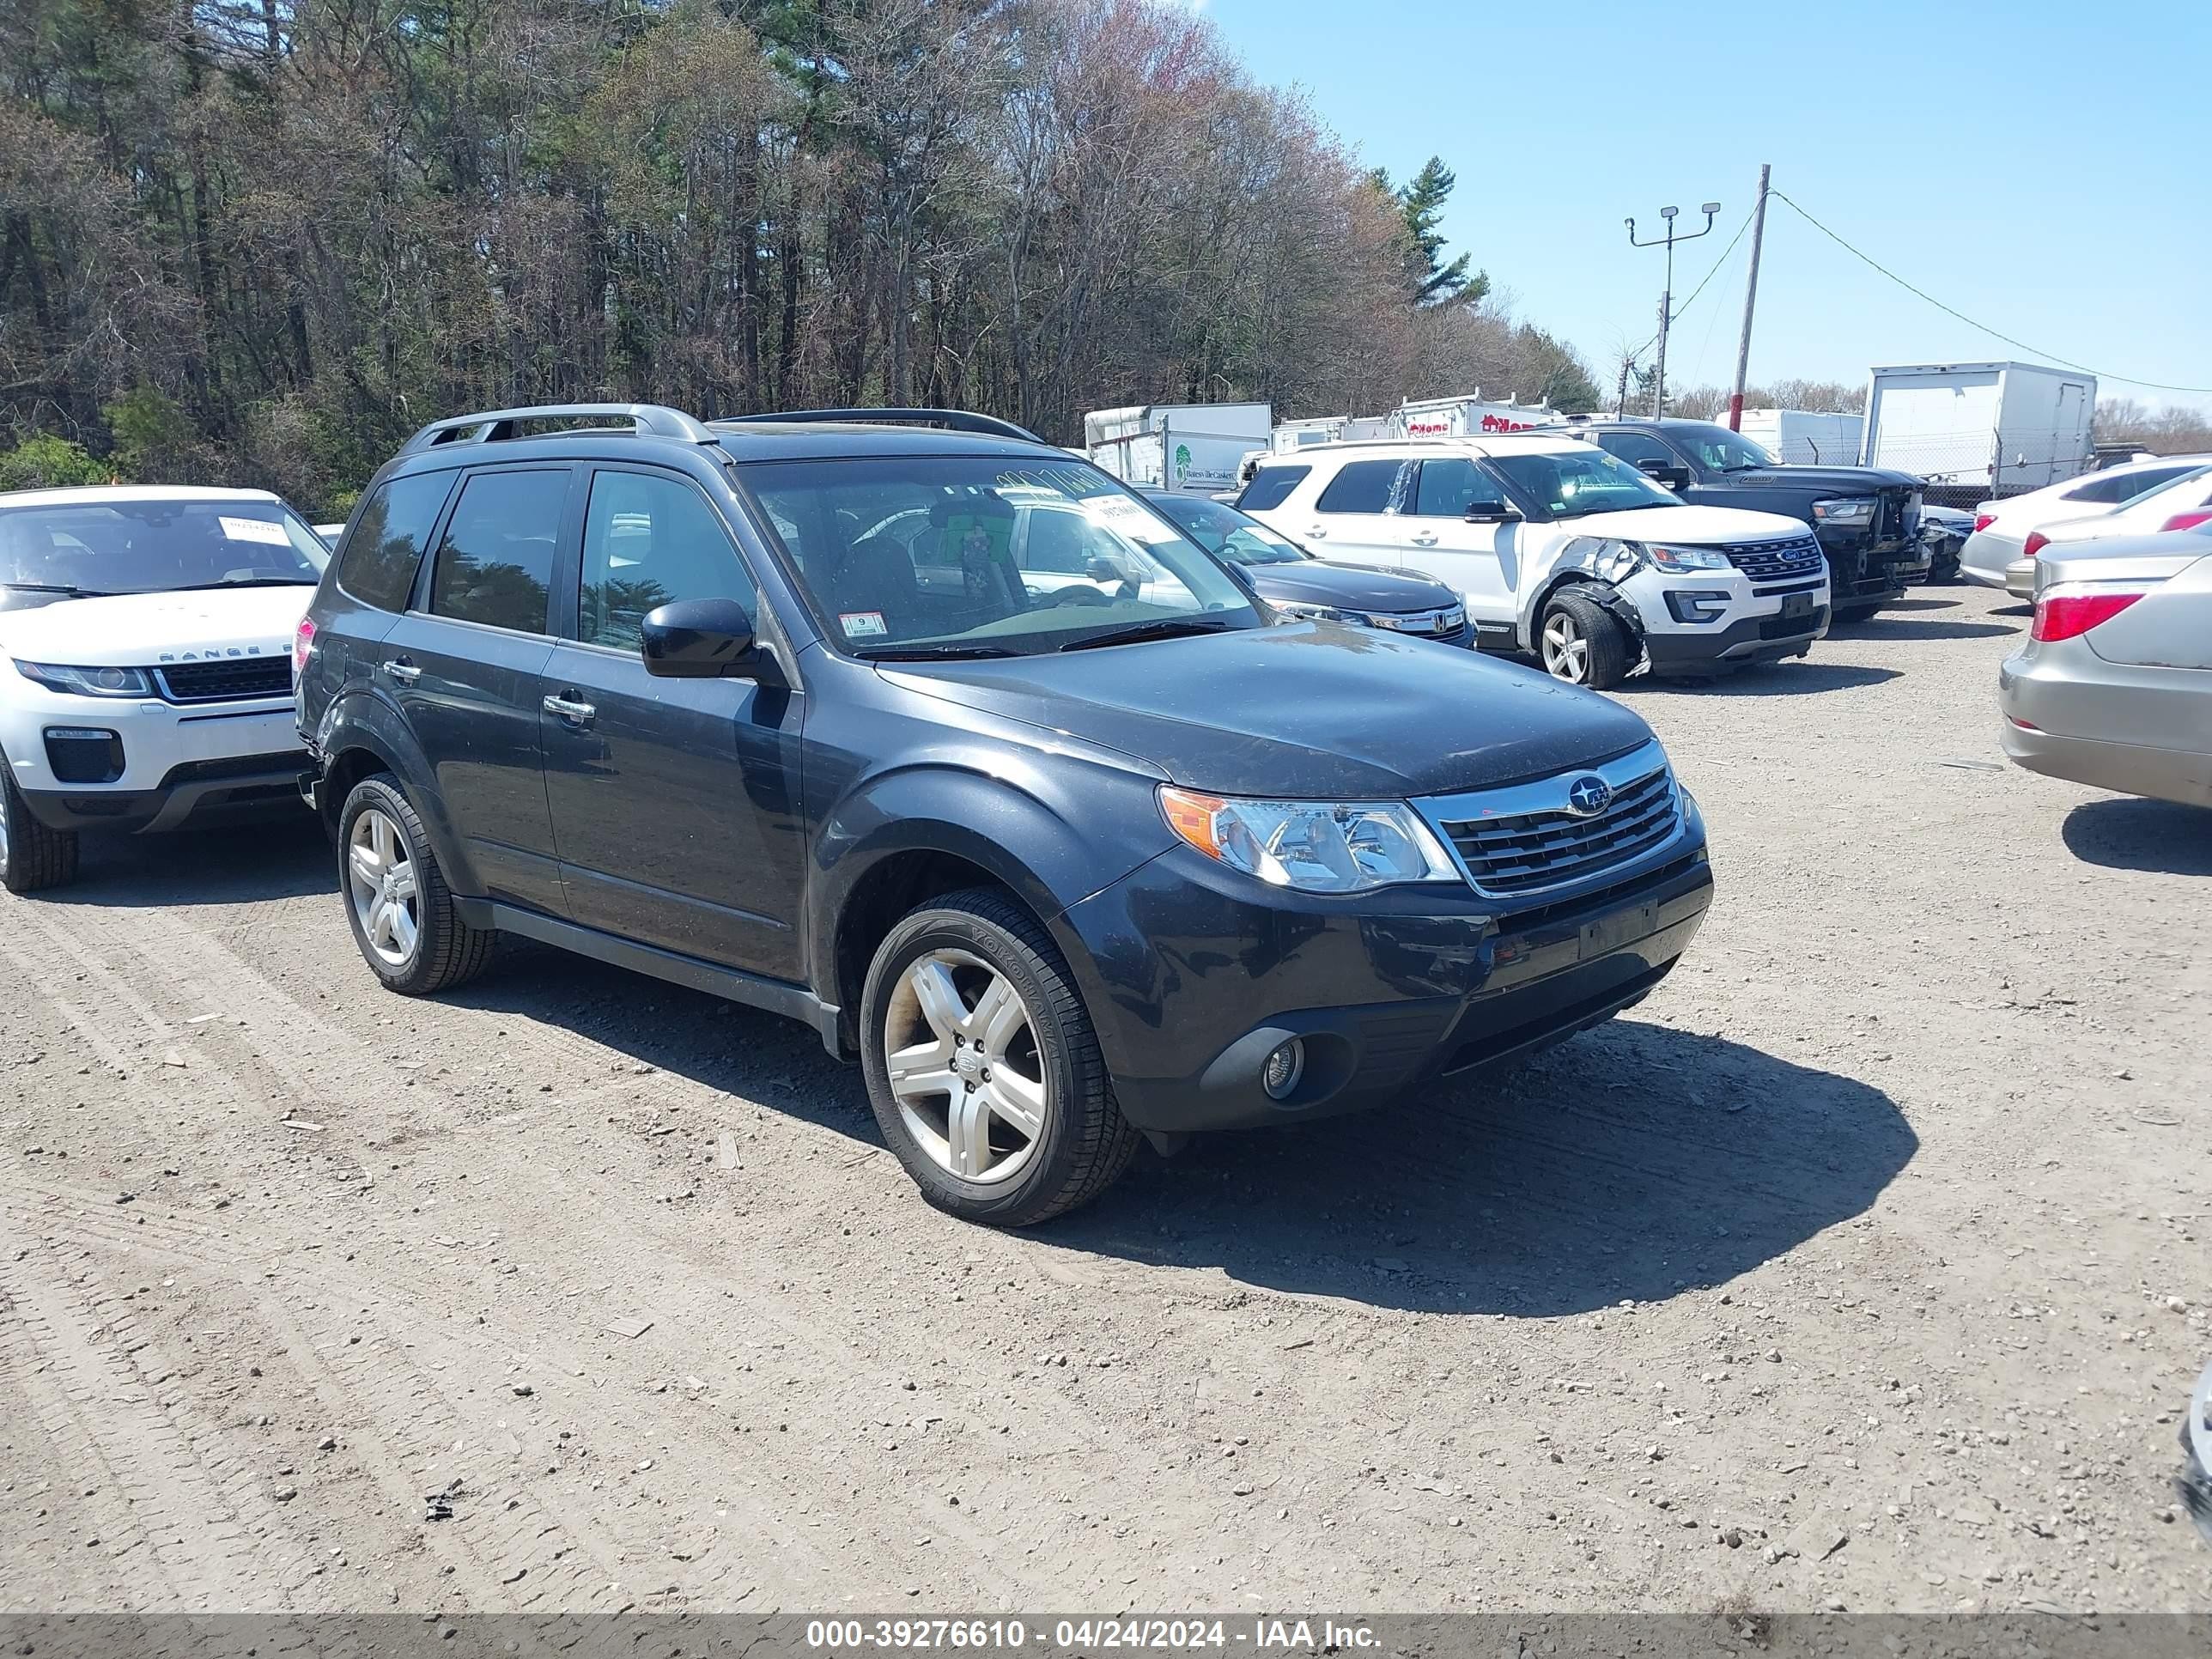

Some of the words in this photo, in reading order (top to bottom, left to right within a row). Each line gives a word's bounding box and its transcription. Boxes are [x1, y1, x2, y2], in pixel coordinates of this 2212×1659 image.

[858, 617, 866, 626] 9
[159, 646, 260, 662] RANGE
[971, 927, 1060, 1059] YOKOHAMA
